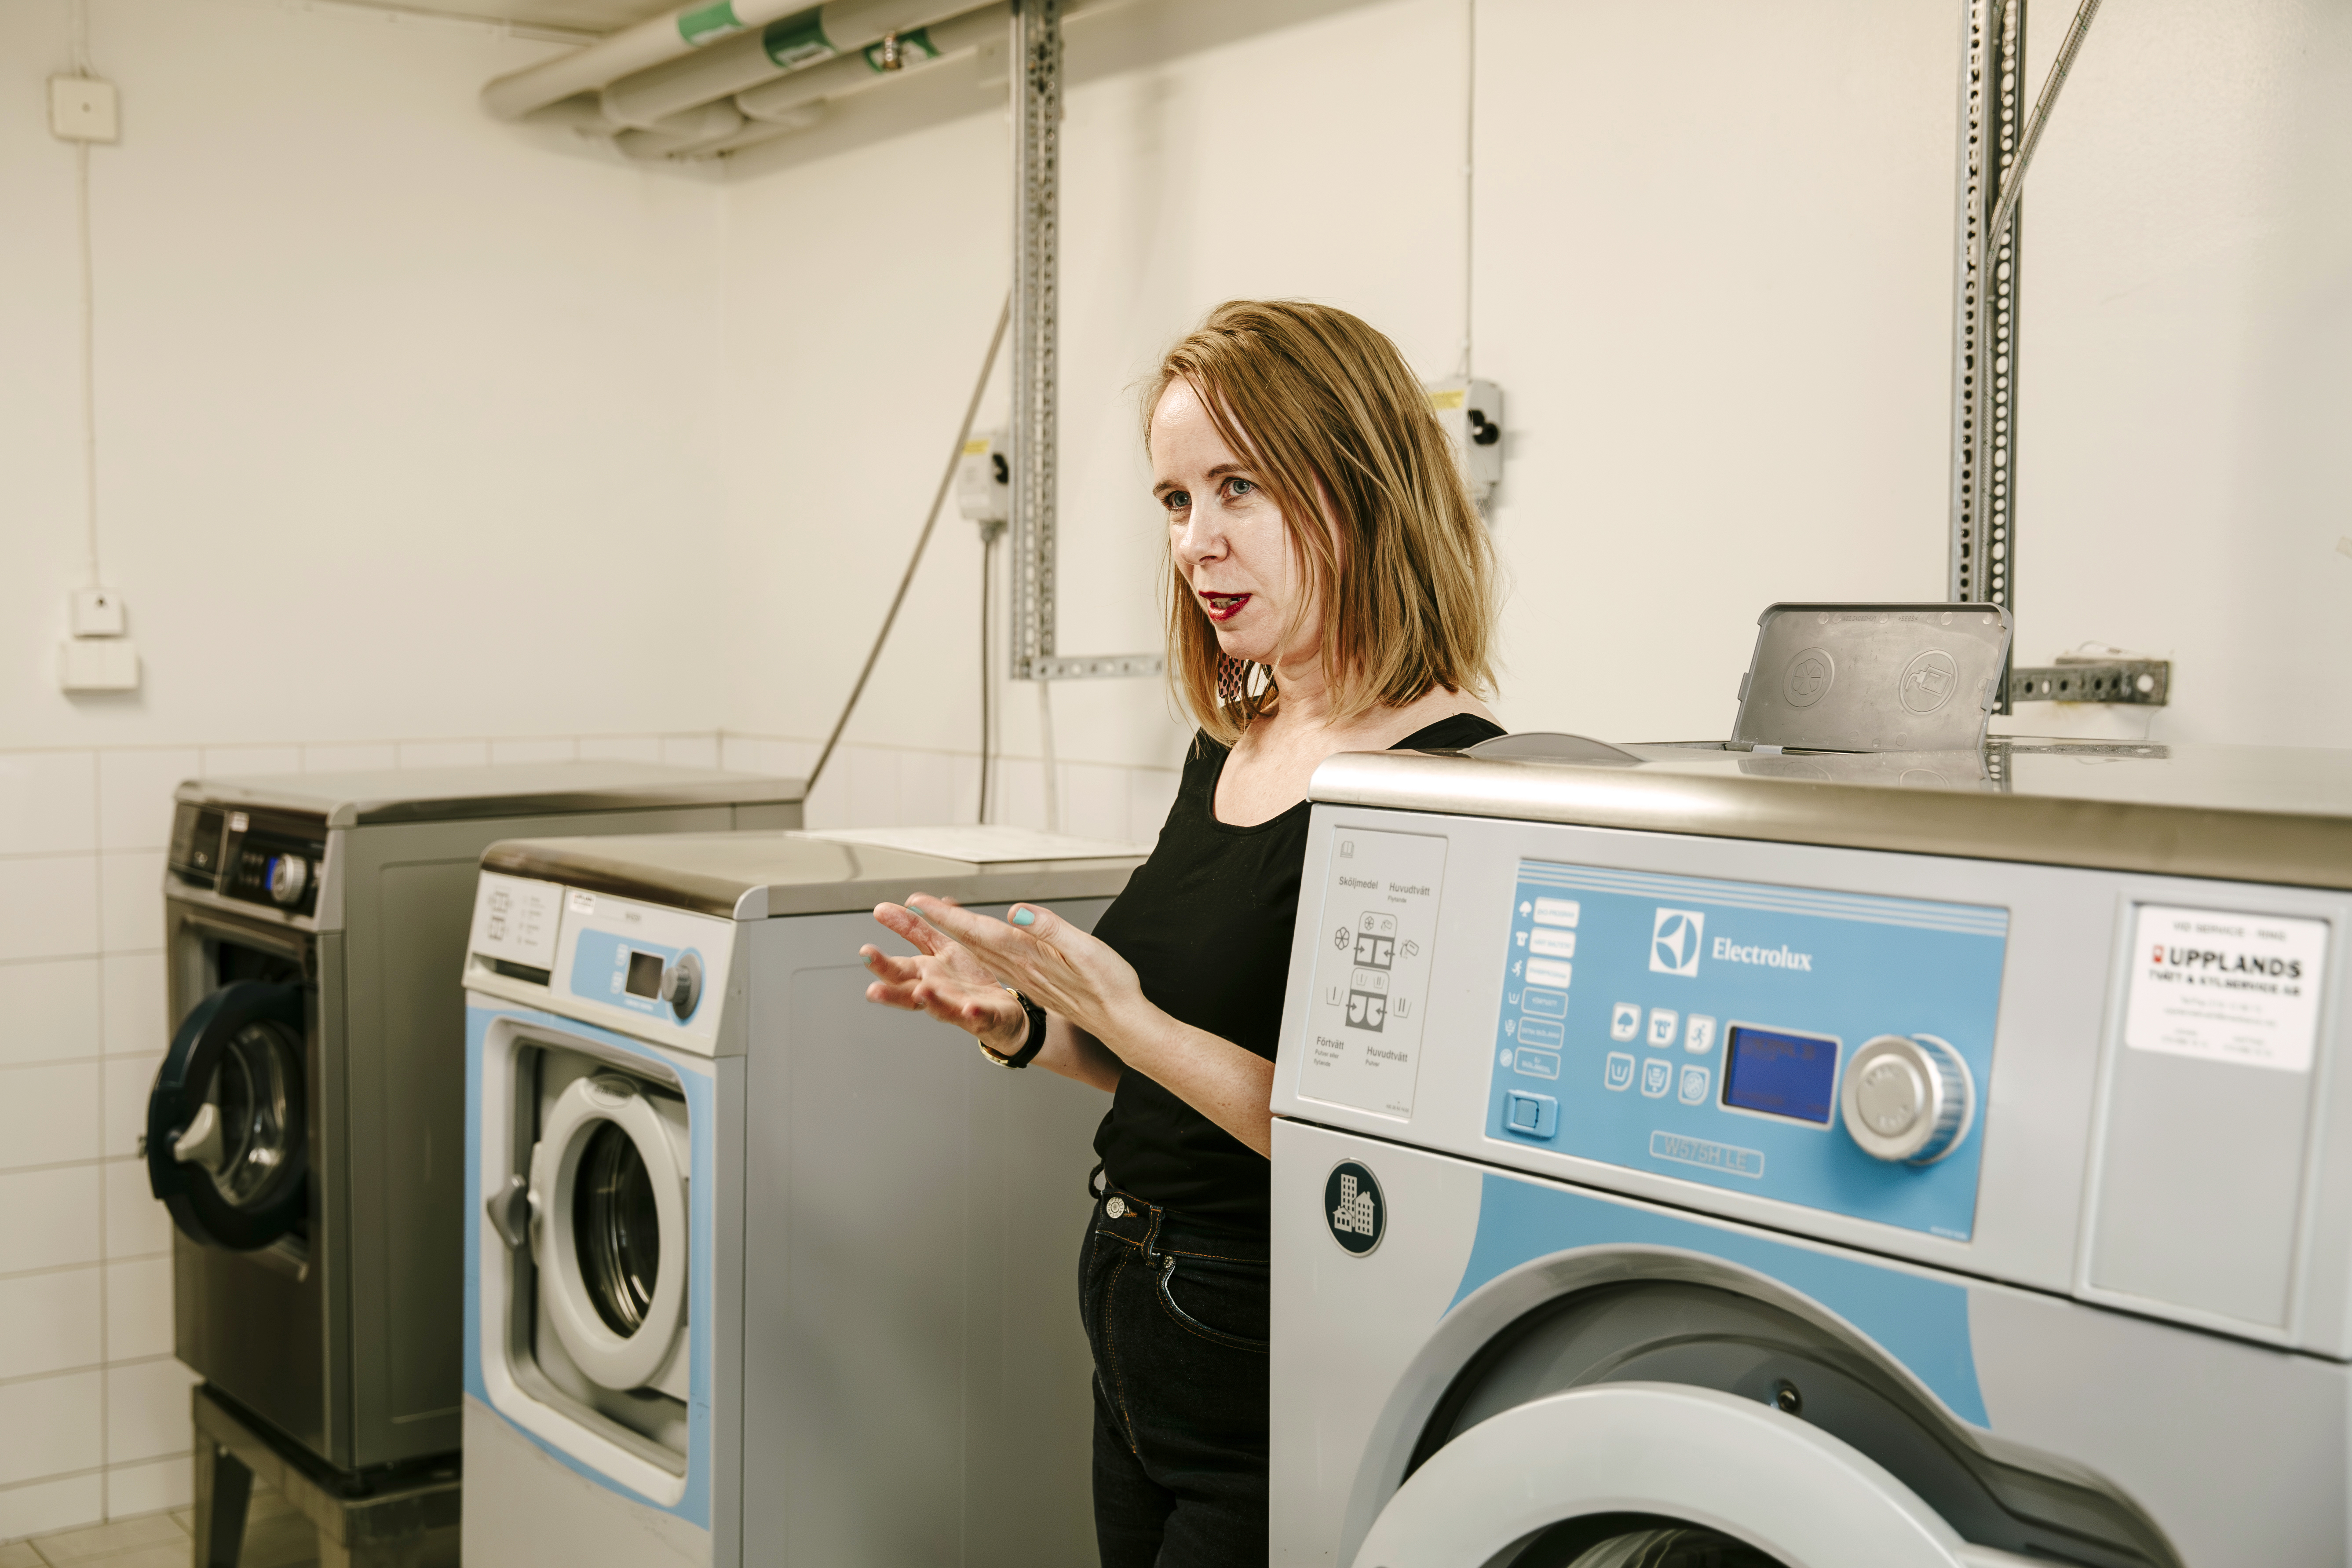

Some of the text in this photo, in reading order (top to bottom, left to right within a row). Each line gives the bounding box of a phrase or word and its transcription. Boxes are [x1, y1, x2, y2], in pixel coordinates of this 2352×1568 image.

[1339, 876, 1378, 889] Sköljmedel
[1389, 882, 1431, 895] Huvudtvätt
[1712, 936, 1812, 972] Electrolux
[2170, 947, 2301, 979] UPPLANDS
[1316, 1036, 1344, 1050] Förtvätt
[1367, 1045, 1408, 1062] Huvudtvätt
[1665, 1136, 1748, 1170] W575H LE
